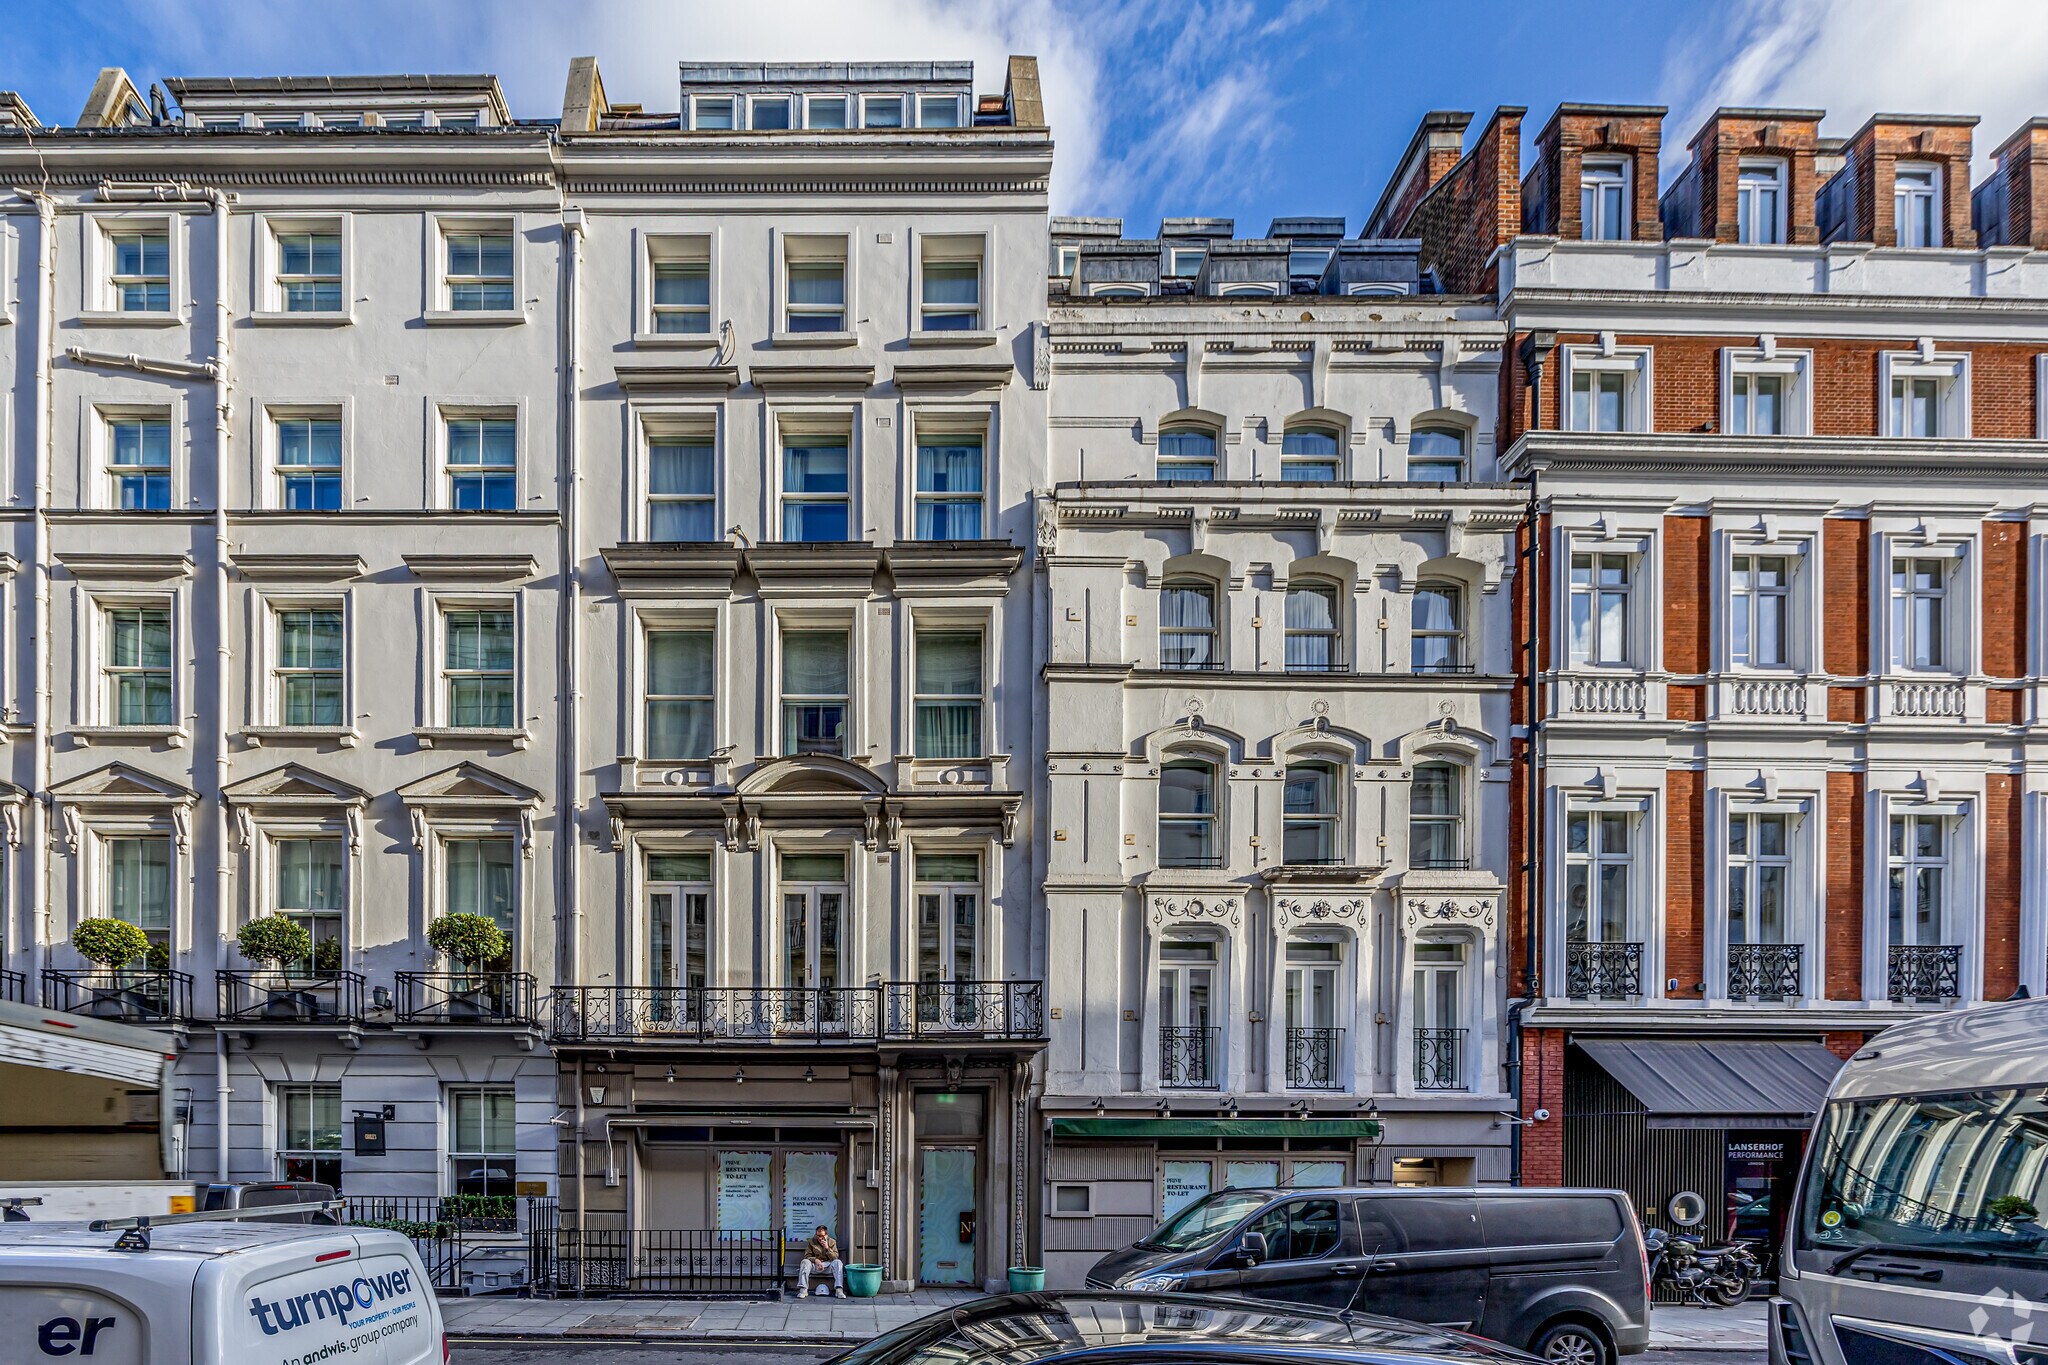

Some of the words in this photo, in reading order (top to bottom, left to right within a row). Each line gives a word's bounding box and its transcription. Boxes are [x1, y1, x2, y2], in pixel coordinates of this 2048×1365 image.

[1728, 1143, 1784, 1151] LANSERHOF
[1728, 1151, 1784, 1159] PERFORMANCE
[961, 1221, 971, 1233] N
[249, 1267, 412, 1336] turnpower
[348, 1319, 365, 1330] YOUR
[365, 1310, 389, 1324] PROPERTY
[392, 1306, 402, 1315] OUR
[402, 1301, 416, 1312] PEOPLE
[381, 1314, 418, 1337] company
[38, 1317, 116, 1356] er
